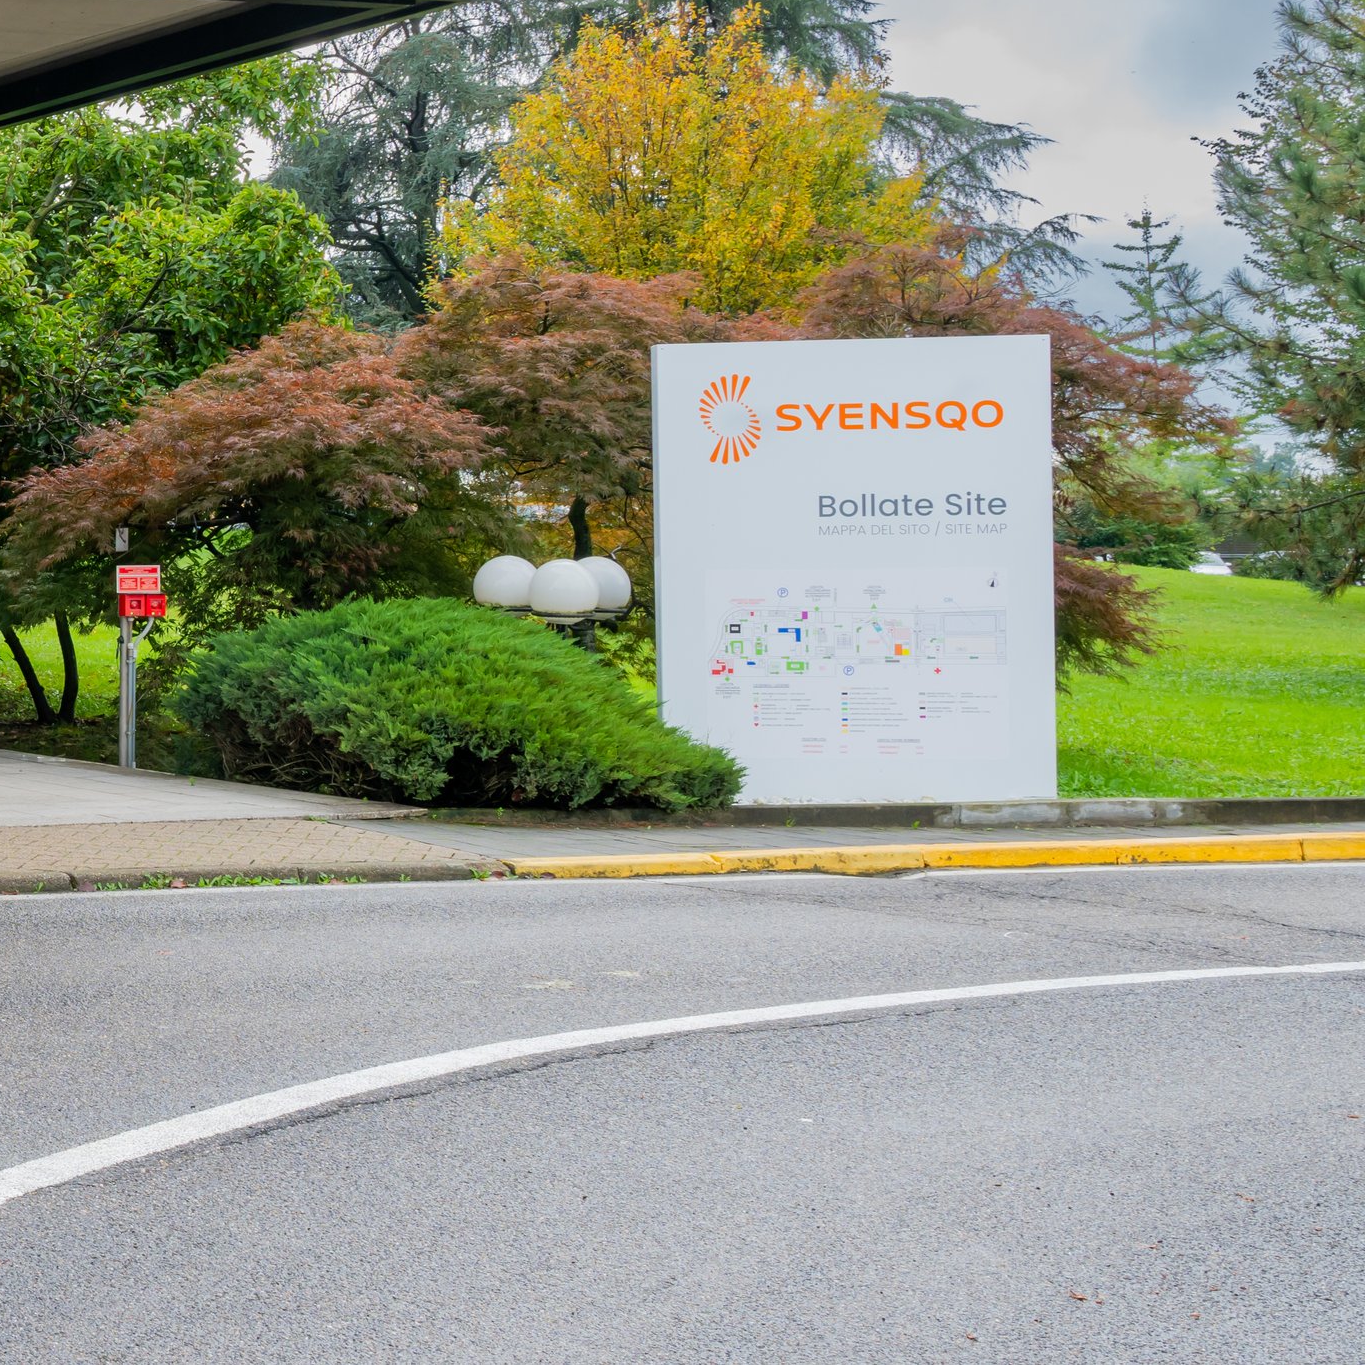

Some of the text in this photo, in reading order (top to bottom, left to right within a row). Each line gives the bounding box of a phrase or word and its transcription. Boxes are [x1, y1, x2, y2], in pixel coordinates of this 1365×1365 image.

[775, 400, 1004, 431] SYENSQO
[818, 491, 1007, 518] Bollate Site
[818, 521, 1008, 537] MAPPA DEL SITO / SITE MAP
